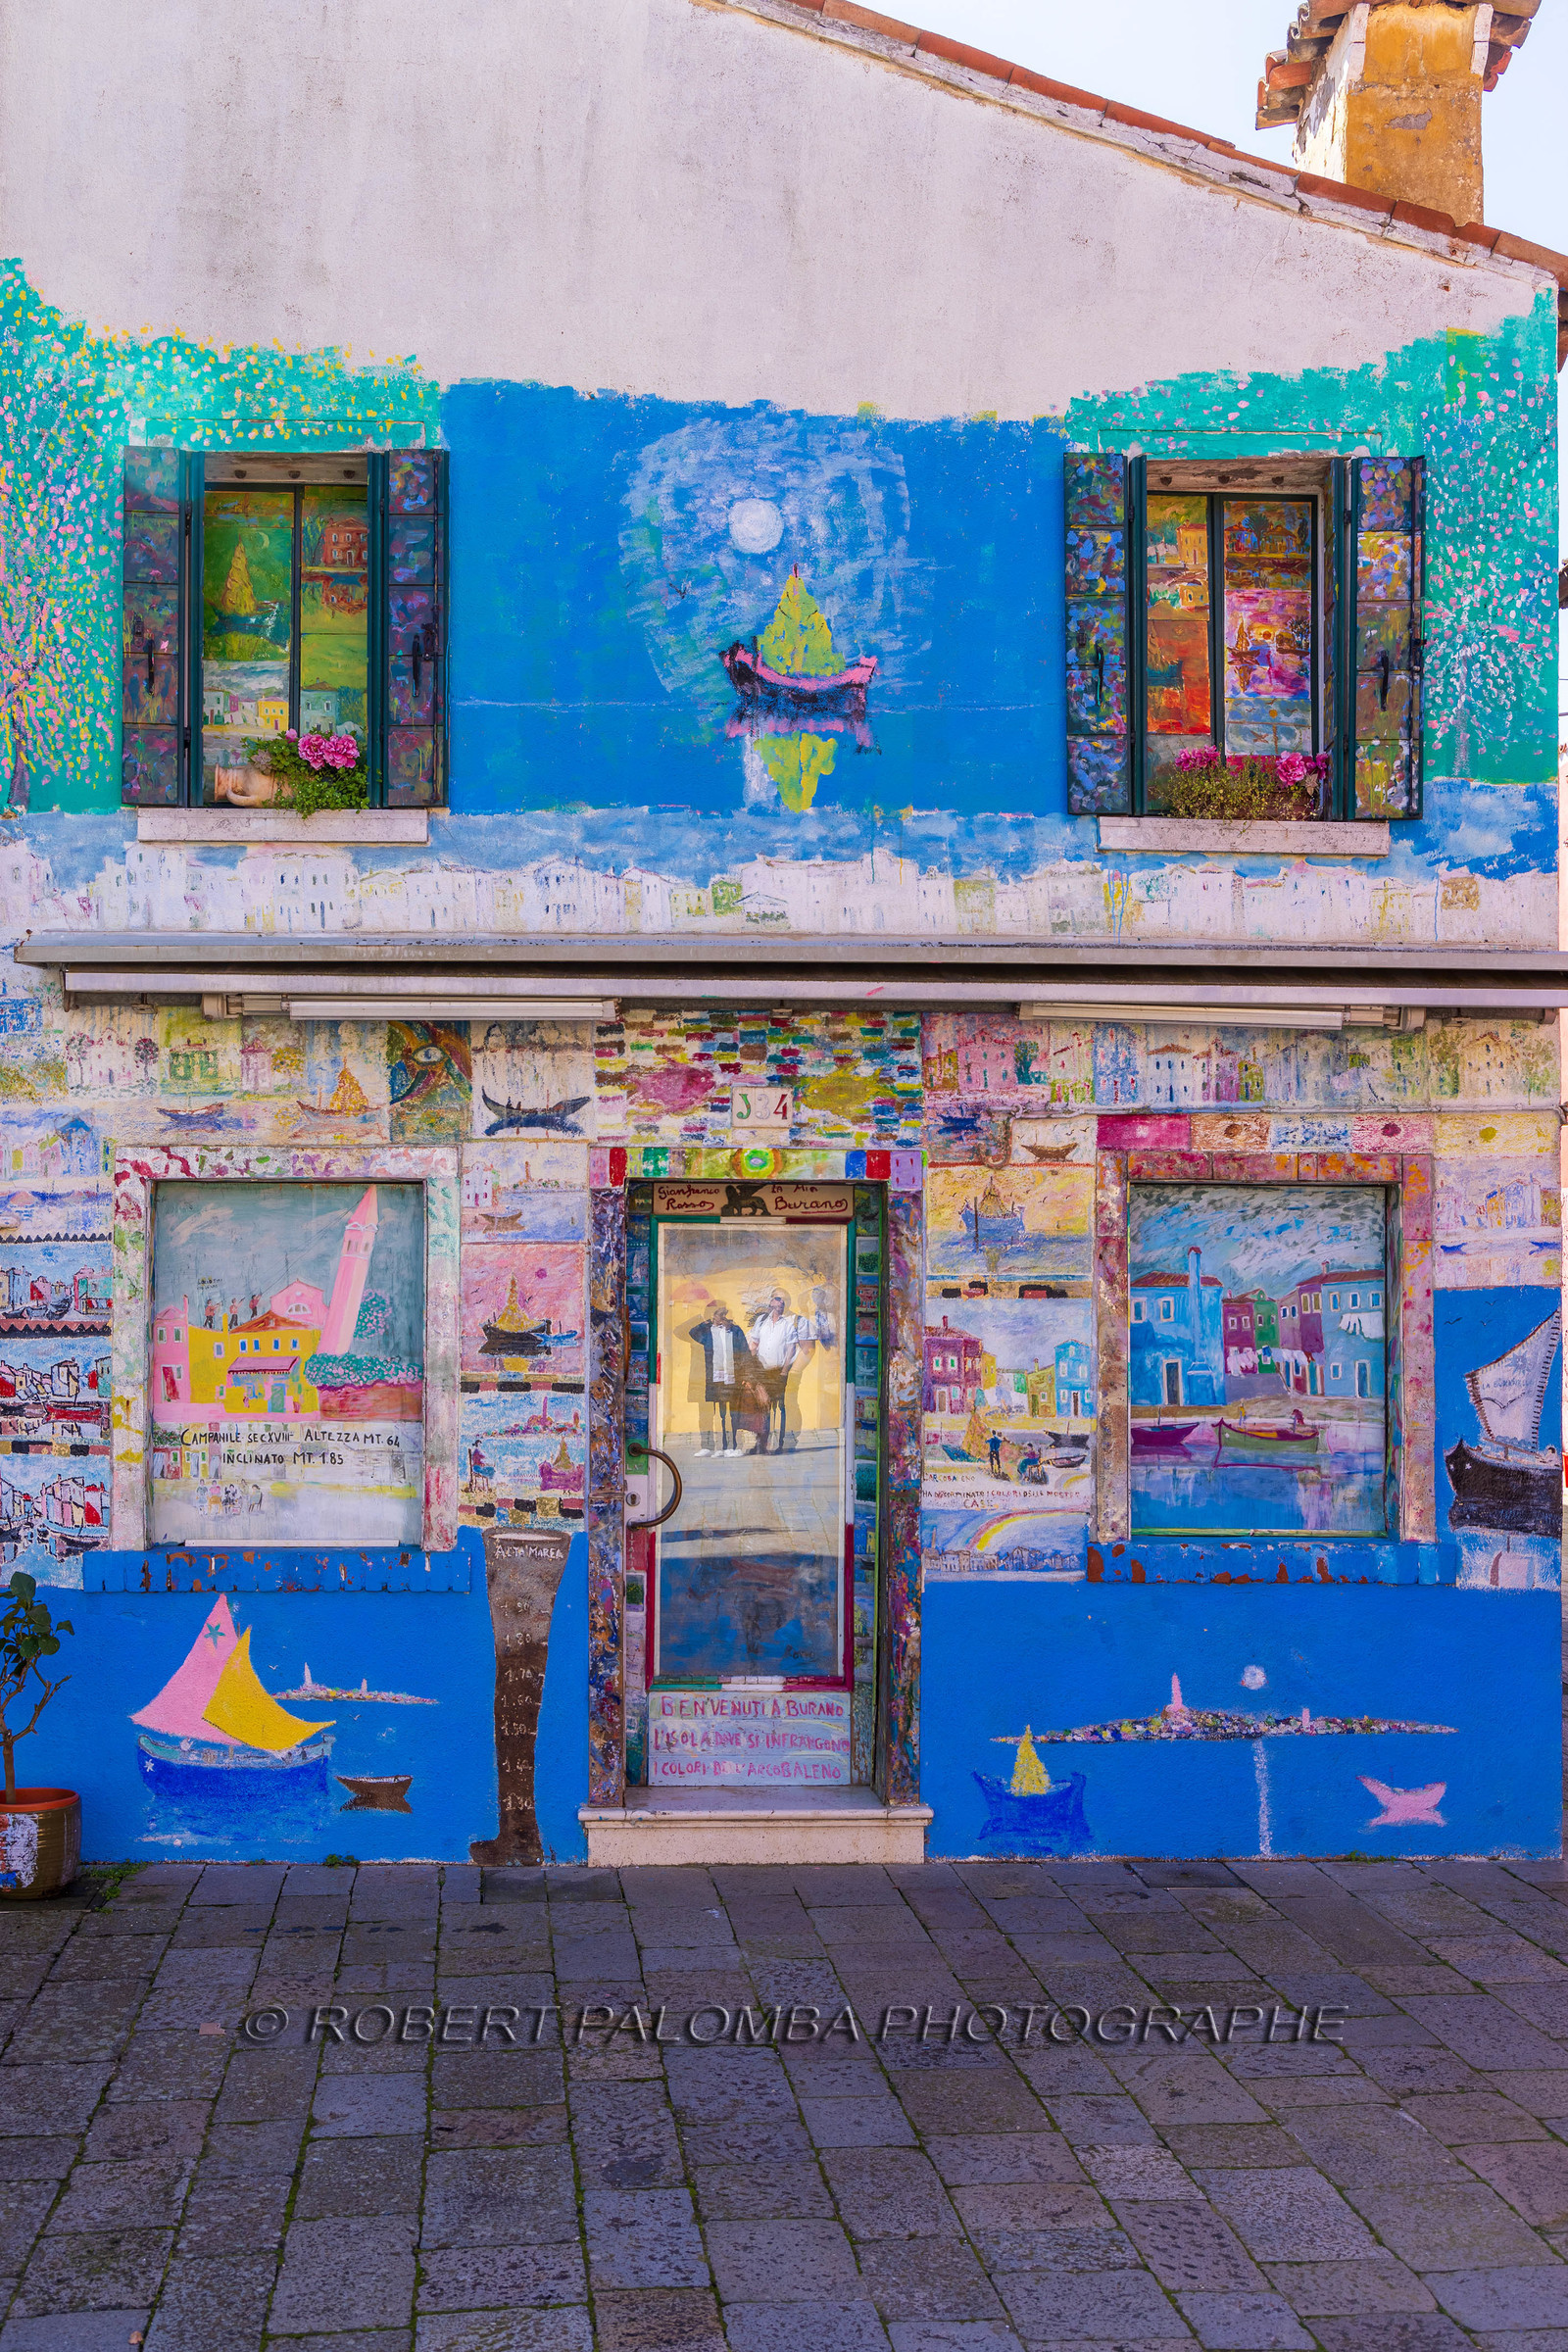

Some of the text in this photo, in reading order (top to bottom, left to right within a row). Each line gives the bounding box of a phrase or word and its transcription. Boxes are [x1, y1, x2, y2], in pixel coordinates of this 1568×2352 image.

[665, 1198, 715, 1213] Rosso
[774, 1196, 849, 1214] Burano
[180, 1428, 242, 1446] CAMPANILE
[304, 1428, 360, 1444] ALTEZZA
[386, 1435, 400, 1448] 64
[222, 1451, 284, 1466] INCLINATO
[318, 1450, 344, 1465] 1.85
[661, 1695, 844, 1717] BENVENUTI A BURANO
[662, 1761, 708, 1776] COLORI
